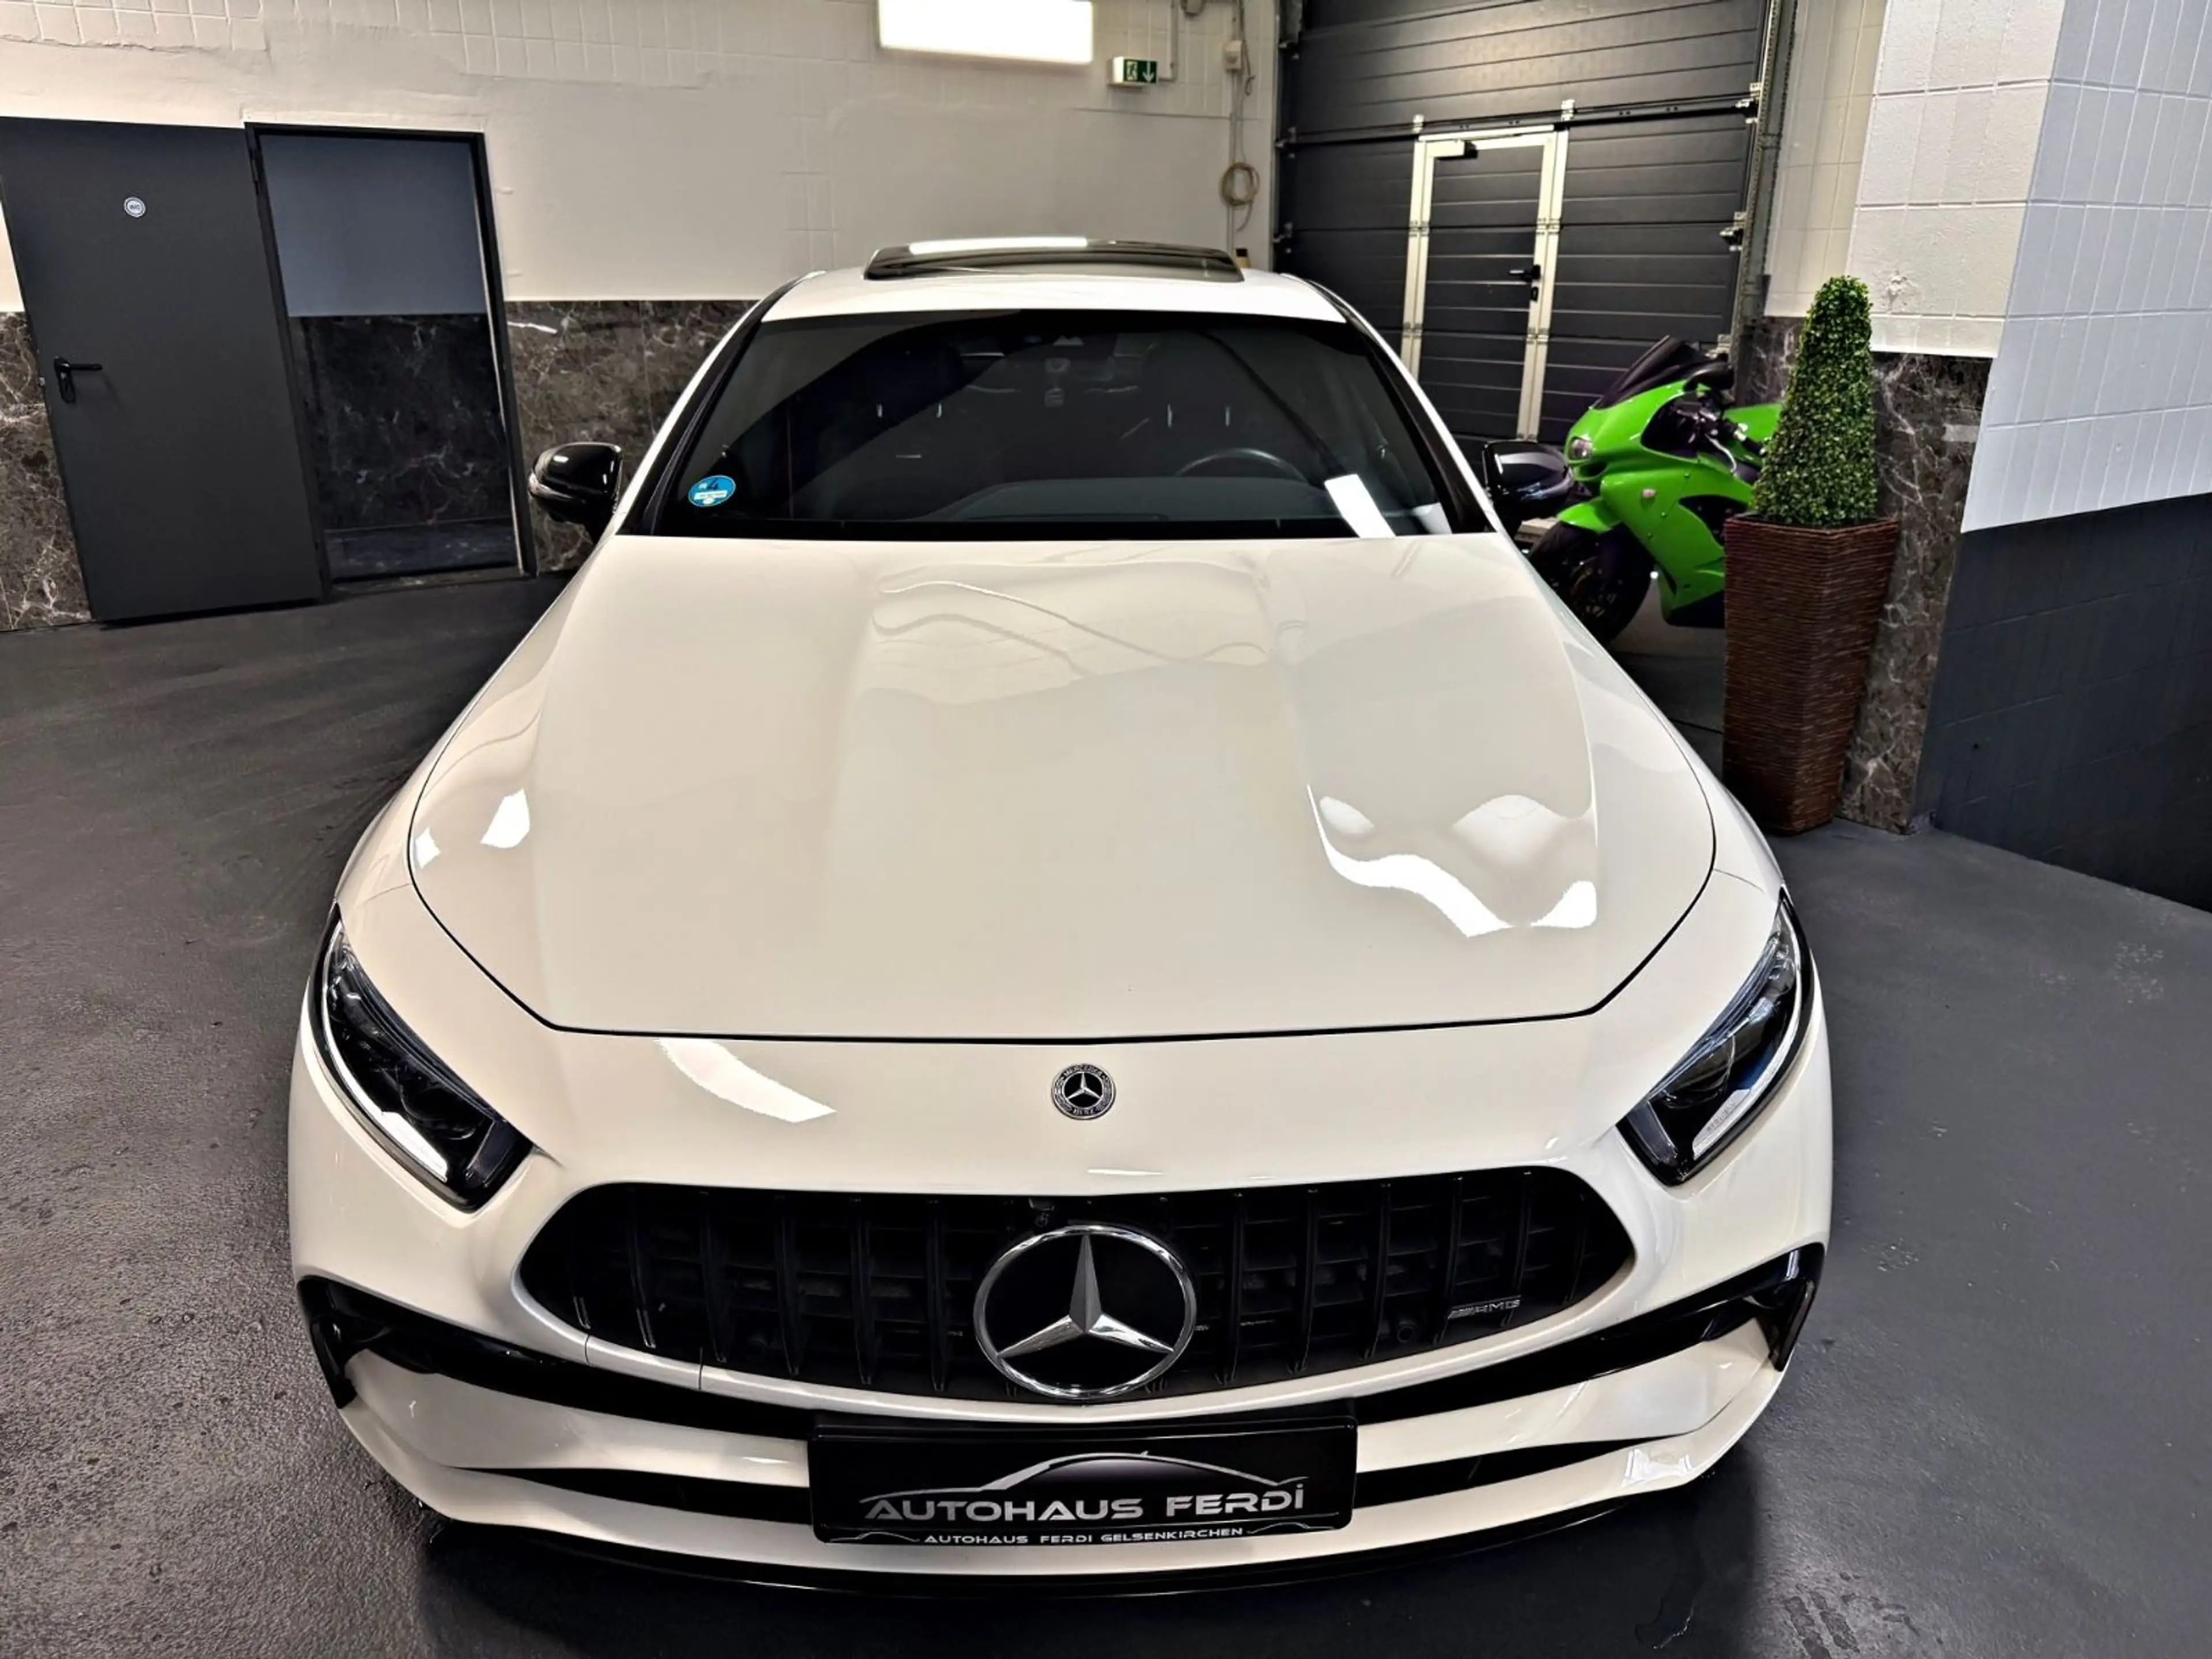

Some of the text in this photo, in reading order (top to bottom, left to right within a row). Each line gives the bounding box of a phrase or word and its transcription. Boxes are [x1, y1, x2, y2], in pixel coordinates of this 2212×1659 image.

[864, 1498, 1143, 1521] AUTOHAUS
[924, 1527, 1243, 1544] AUTOHAUS FERDI GELSENKIRCHEN
